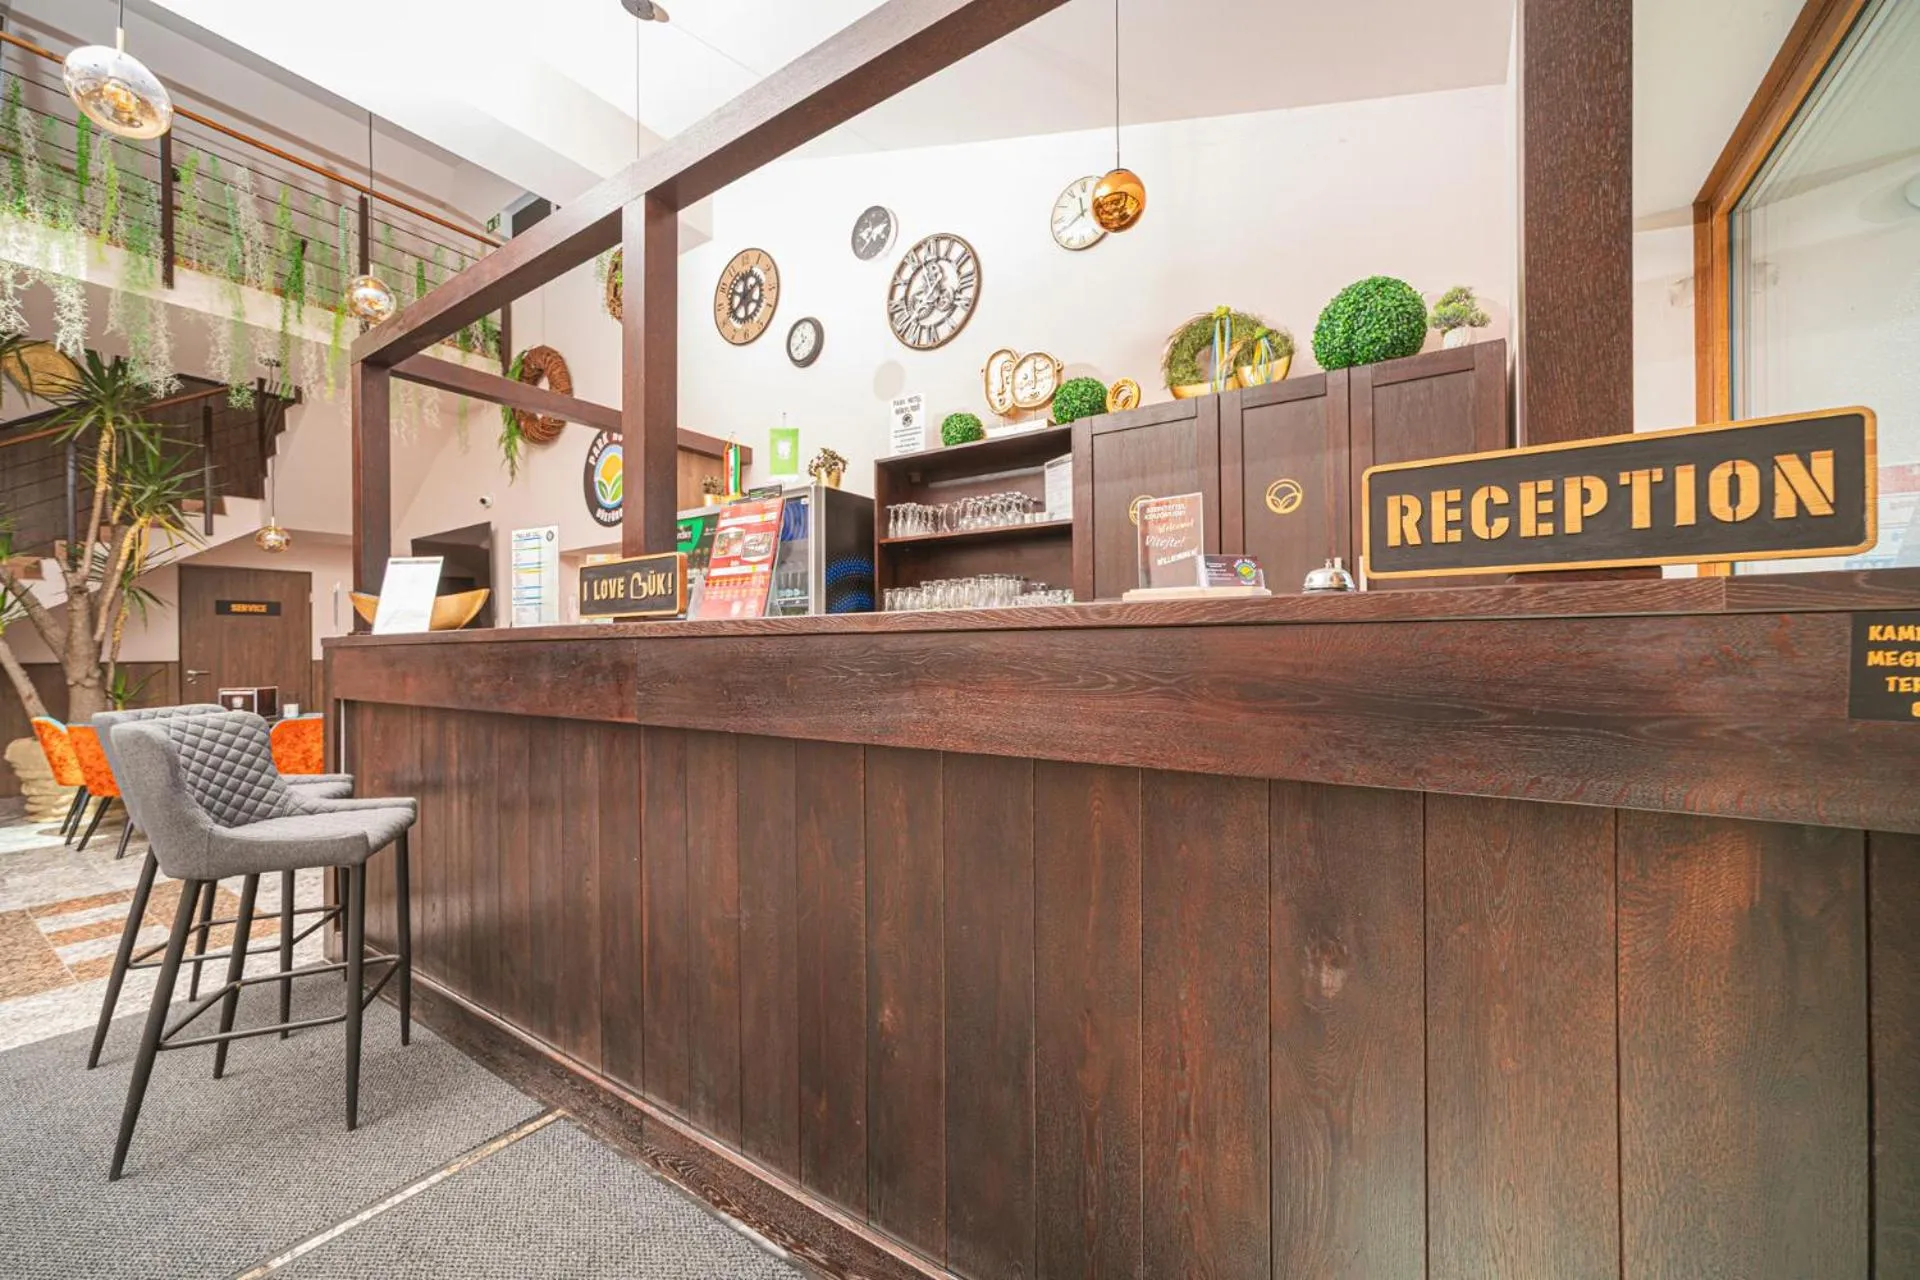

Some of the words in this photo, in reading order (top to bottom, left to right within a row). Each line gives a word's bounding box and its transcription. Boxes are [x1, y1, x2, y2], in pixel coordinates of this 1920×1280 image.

[588, 430, 609, 466] PARK
[1386, 449, 1835, 548] RECEPTION
[583, 581, 588, 602] I
[593, 577, 625, 601] LOVE
[230, 603, 268, 613] SERVICE
